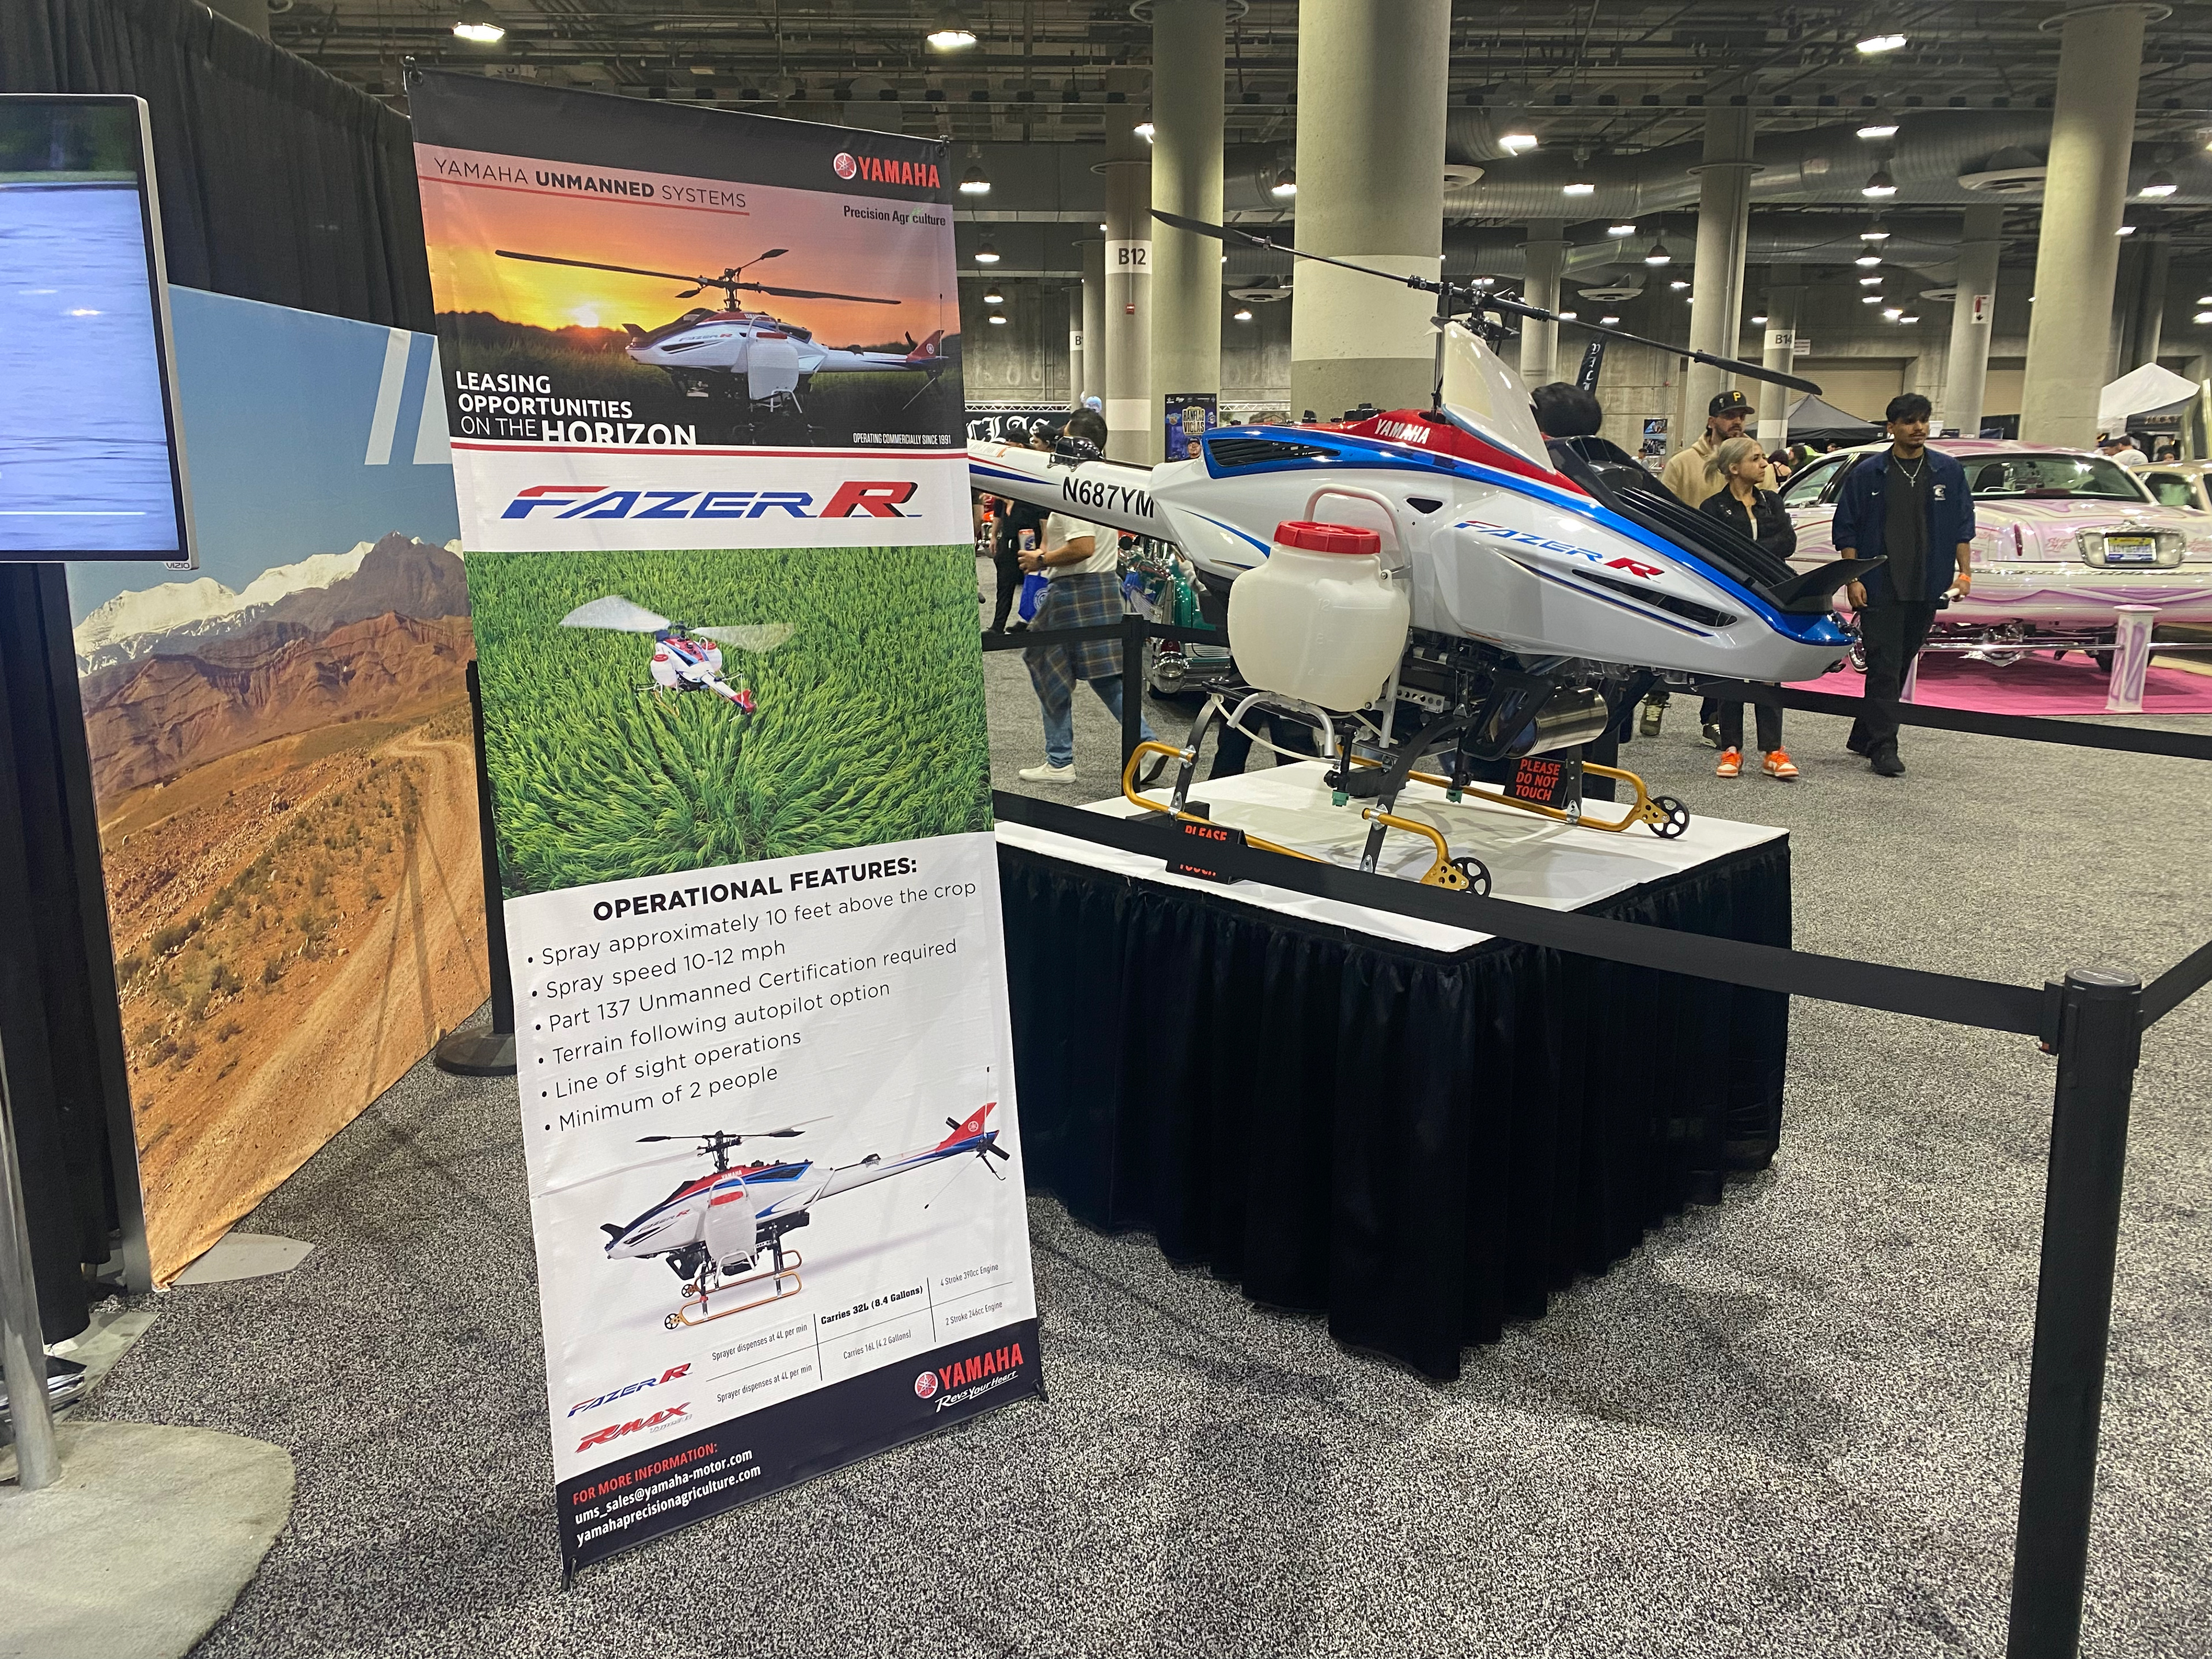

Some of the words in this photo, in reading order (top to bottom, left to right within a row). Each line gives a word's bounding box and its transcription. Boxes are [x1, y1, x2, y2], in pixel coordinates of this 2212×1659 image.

[434, 158, 528, 184] YAMAHA
[535, 171, 654, 198] UNMANNED
[662, 185, 746, 208] SYSTEMS
[858, 156, 941, 188] YAMAHA
[843, 205, 890, 221] Precision
[1118, 248, 1146, 265] B12
[1075, 335, 1083, 346] B
[1775, 334, 1792, 344] B14
[456, 370, 551, 394] LEASING
[1733, 392, 1741, 402] P
[458, 393, 633, 419] OPPORTUNITIES
[460, 415, 490, 436] ON
[495, 417, 537, 437] THE
[541, 420, 697, 445] HORIZON
[853, 433, 882, 444] OPERATING
[882, 433, 922, 445] COMMERCIALLY
[922, 434, 938, 445] SINCE
[939, 434, 952, 445] 1991
[1374, 419, 1431, 444] YAMAHA
[500, 485, 818, 518] FAZER
[818, 481, 919, 518] R
[1063, 476, 1154, 518] N687YM
[1453, 520, 1604, 565] FAZER
[1603, 556, 1665, 581] R
[1318, 598, 1330, 612] 12
[1516, 771, 1532, 785] DO
[1534, 774, 1559, 789] NOT
[1520, 758, 1562, 776] PLEASE
[1516, 785, 1552, 801] TOUCH
[593, 877, 783, 921] OPERATIONAL
[790, 857, 918, 891] FEATURES:
[542, 942, 601, 966] Spray
[609, 914, 759, 953] approximately
[766, 908, 787, 926] 10
[794, 902, 832, 922] feet
[838, 895, 893, 914] above
[899, 888, 928, 904] the
[934, 882, 976, 899] crop
[546, 974, 604, 999] Spray
[612, 957, 677, 984] speed
[683, 948, 734, 972] 10-12
[741, 940, 786, 961] mph
[549, 1007, 590, 1032] Part
[597, 998, 631, 1021] 137
[639, 975, 751, 1012] Unmanned
[759, 956, 877, 990] Certification
[883, 938, 957, 967] required
[552, 1036, 623, 1065] Terrain
[631, 1016, 726, 1047] following
[734, 994, 824, 1025] autopilot
[830, 983, 890, 1007] option
[555, 1076, 599, 1099] Line
[606, 1065, 627, 1085] of
[635, 1054, 687, 1079] sight
[694, 1032, 802, 1066] operations
[559, 1096, 654, 1132] Minimum
[662, 1084, 683, 1105] of
[689, 1081, 702, 1099] 2
[709, 1066, 778, 1097] people
[945, 1274, 963, 1285] Stroke
[963, 1269, 979, 1280] 390cc
[980, 1264, 999, 1274] Engine
[821, 1310, 851, 1325] Carries
[853, 1302, 869, 1315] 32L
[871, 1296, 889, 1310] (8.4
[890, 1285, 923, 1302] Gallons)
[945, 1317, 949, 1325] 2
[950, 1313, 968, 1324] Stroke
[968, 1308, 984, 1319] 246cc
[984, 1302, 1003, 1313] Engine
[712, 1347, 736, 1361] Sprayer
[737, 1336, 768, 1354] dispenses
[768, 1334, 775, 1343] at
[777, 1331, 784, 1339] 4L
[785, 1327, 795, 1339] per
[796, 1324, 808, 1334] min
[843, 1347, 864, 1359] Carries
[865, 1342, 876, 1352] 16L
[876, 1338, 887, 1349] (4.2
[888, 1329, 912, 1344] Gallons)
[717, 1389, 741, 1403] Sprayer
[742, 1378, 772, 1394] dispenses
[774, 1374, 781, 1384] at
[781, 1371, 789, 1380] 4L
[790, 1368, 800, 1380] per
[801, 1364, 812, 1374] min
[938, 1343, 1024, 1391] YAMAHA
[567, 1377, 658, 1418] FAZER
[658, 1362, 691, 1385] R
[934, 1388, 969, 1413] Revs
[968, 1380, 992, 1400] Your
[991, 1370, 1017, 1387] Heart
[575, 1402, 691, 1453] RMAX
[572, 1486, 596, 1506] FOR
[597, 1472, 632, 1495] MORE
[635, 1442, 718, 1482] INFORMATION:
[575, 1449, 753, 1525] ums_sales@yamaha-motor.com
[577, 1465, 762, 1548] yamahaprecisionagriculture.com
